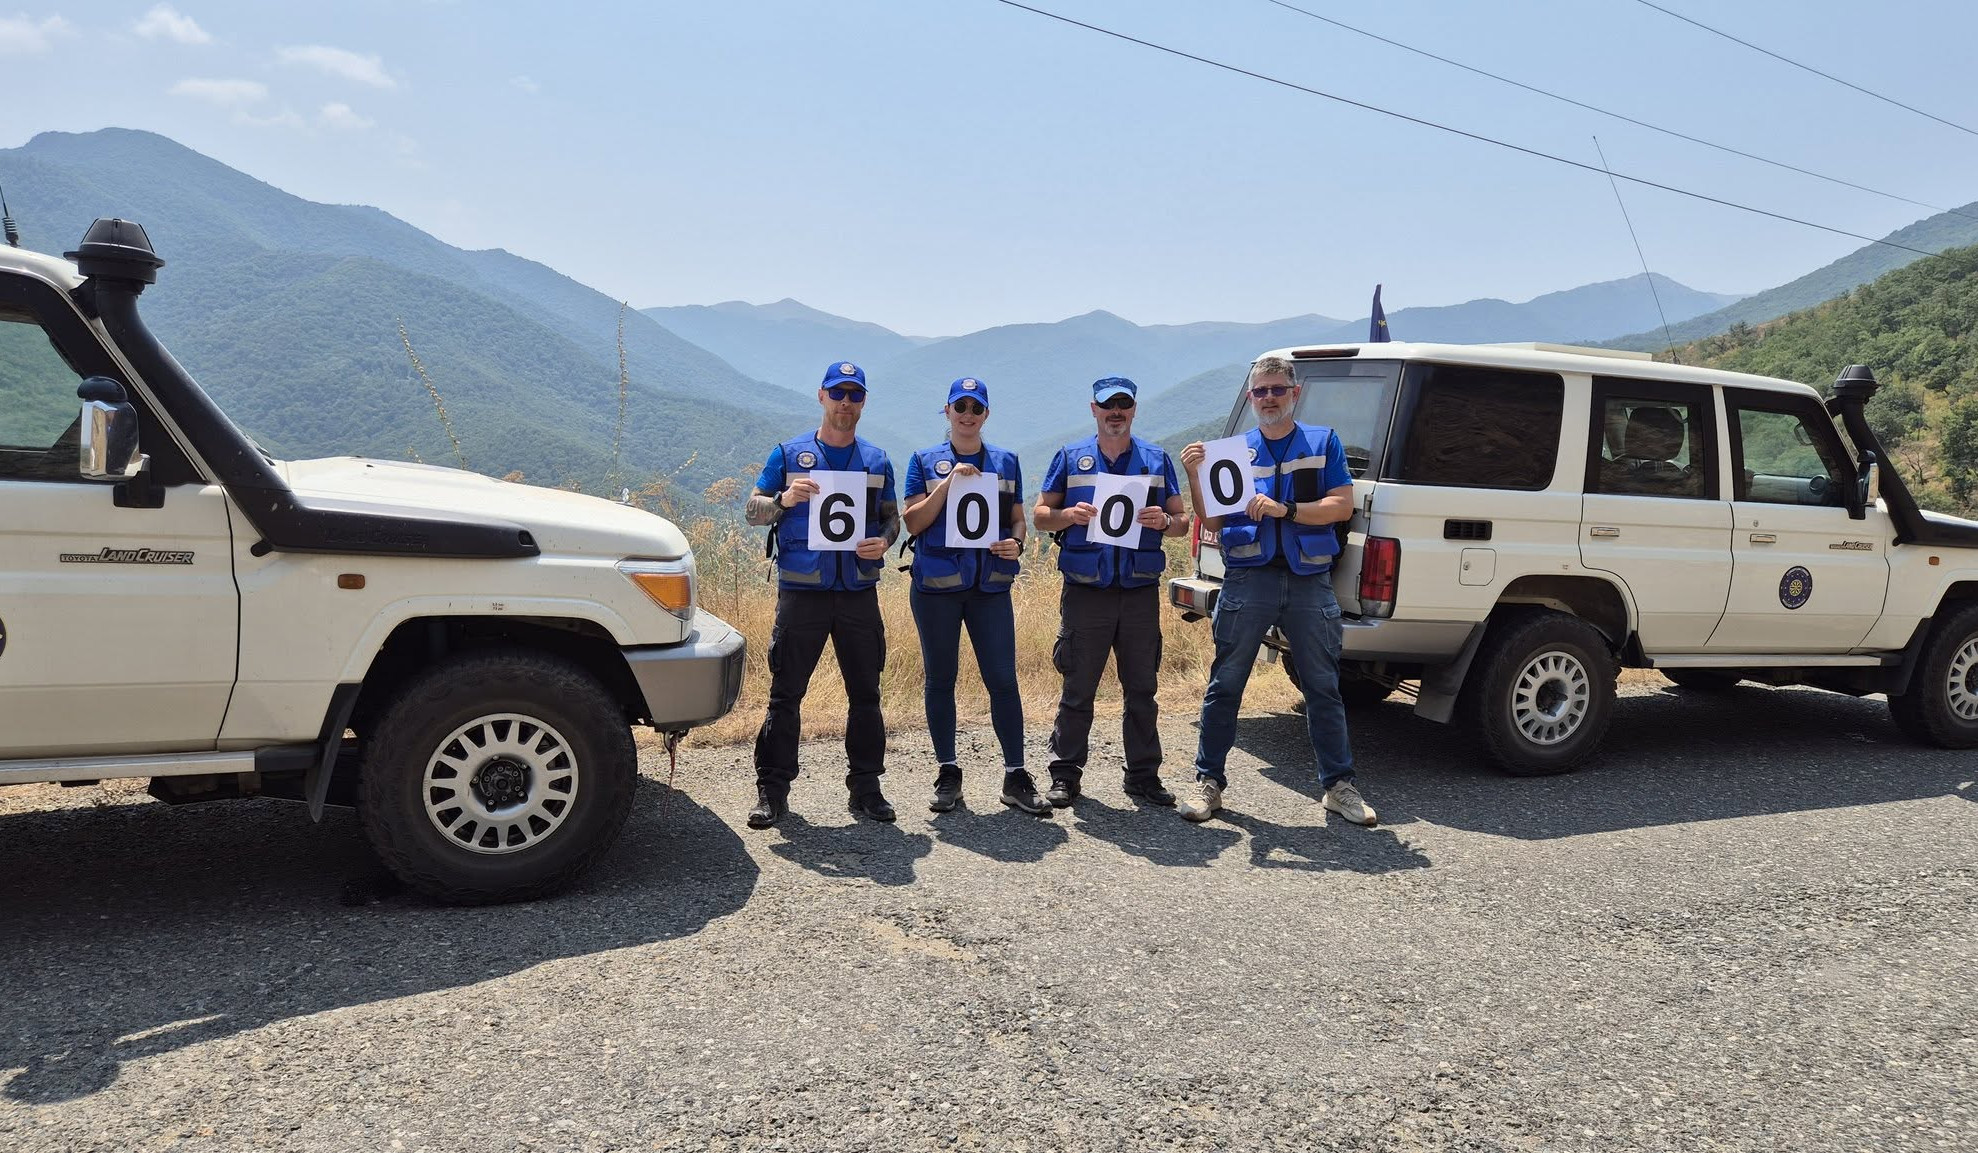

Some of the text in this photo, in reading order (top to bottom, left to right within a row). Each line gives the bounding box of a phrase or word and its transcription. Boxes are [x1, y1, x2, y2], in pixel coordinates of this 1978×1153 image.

[1209, 459, 1244, 506] 0
[819, 492, 856, 543] 6
[956, 492, 990, 541] 0
[1100, 494, 1135, 538] 0
[62, 554, 99, 562] TOYOTA
